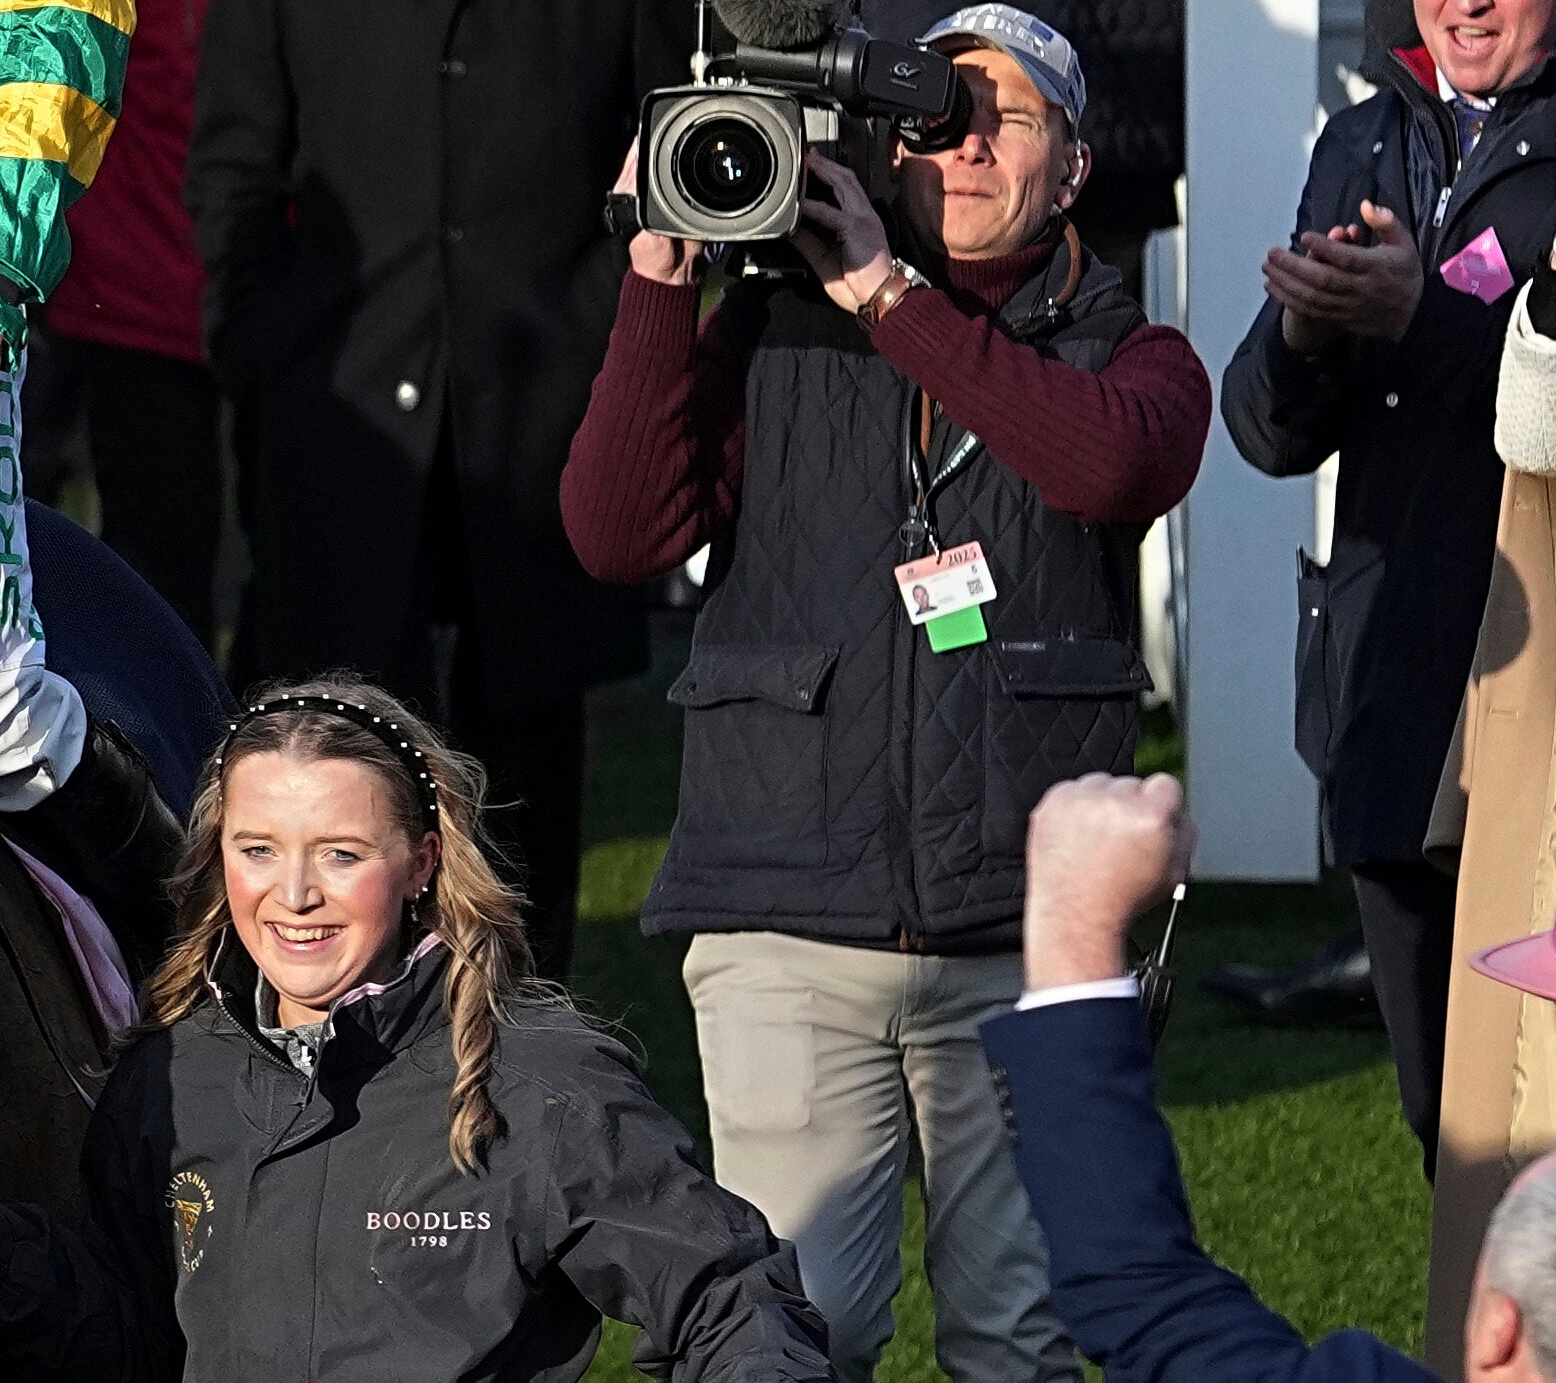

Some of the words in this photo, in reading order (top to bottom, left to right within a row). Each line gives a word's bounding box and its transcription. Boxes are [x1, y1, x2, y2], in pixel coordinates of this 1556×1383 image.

[948, 545, 978, 567] 2025
[164, 1171, 216, 1214] CHELTENHAM
[366, 1211, 492, 1231] BOODLES
[410, 1235, 449, 1248] 1798
